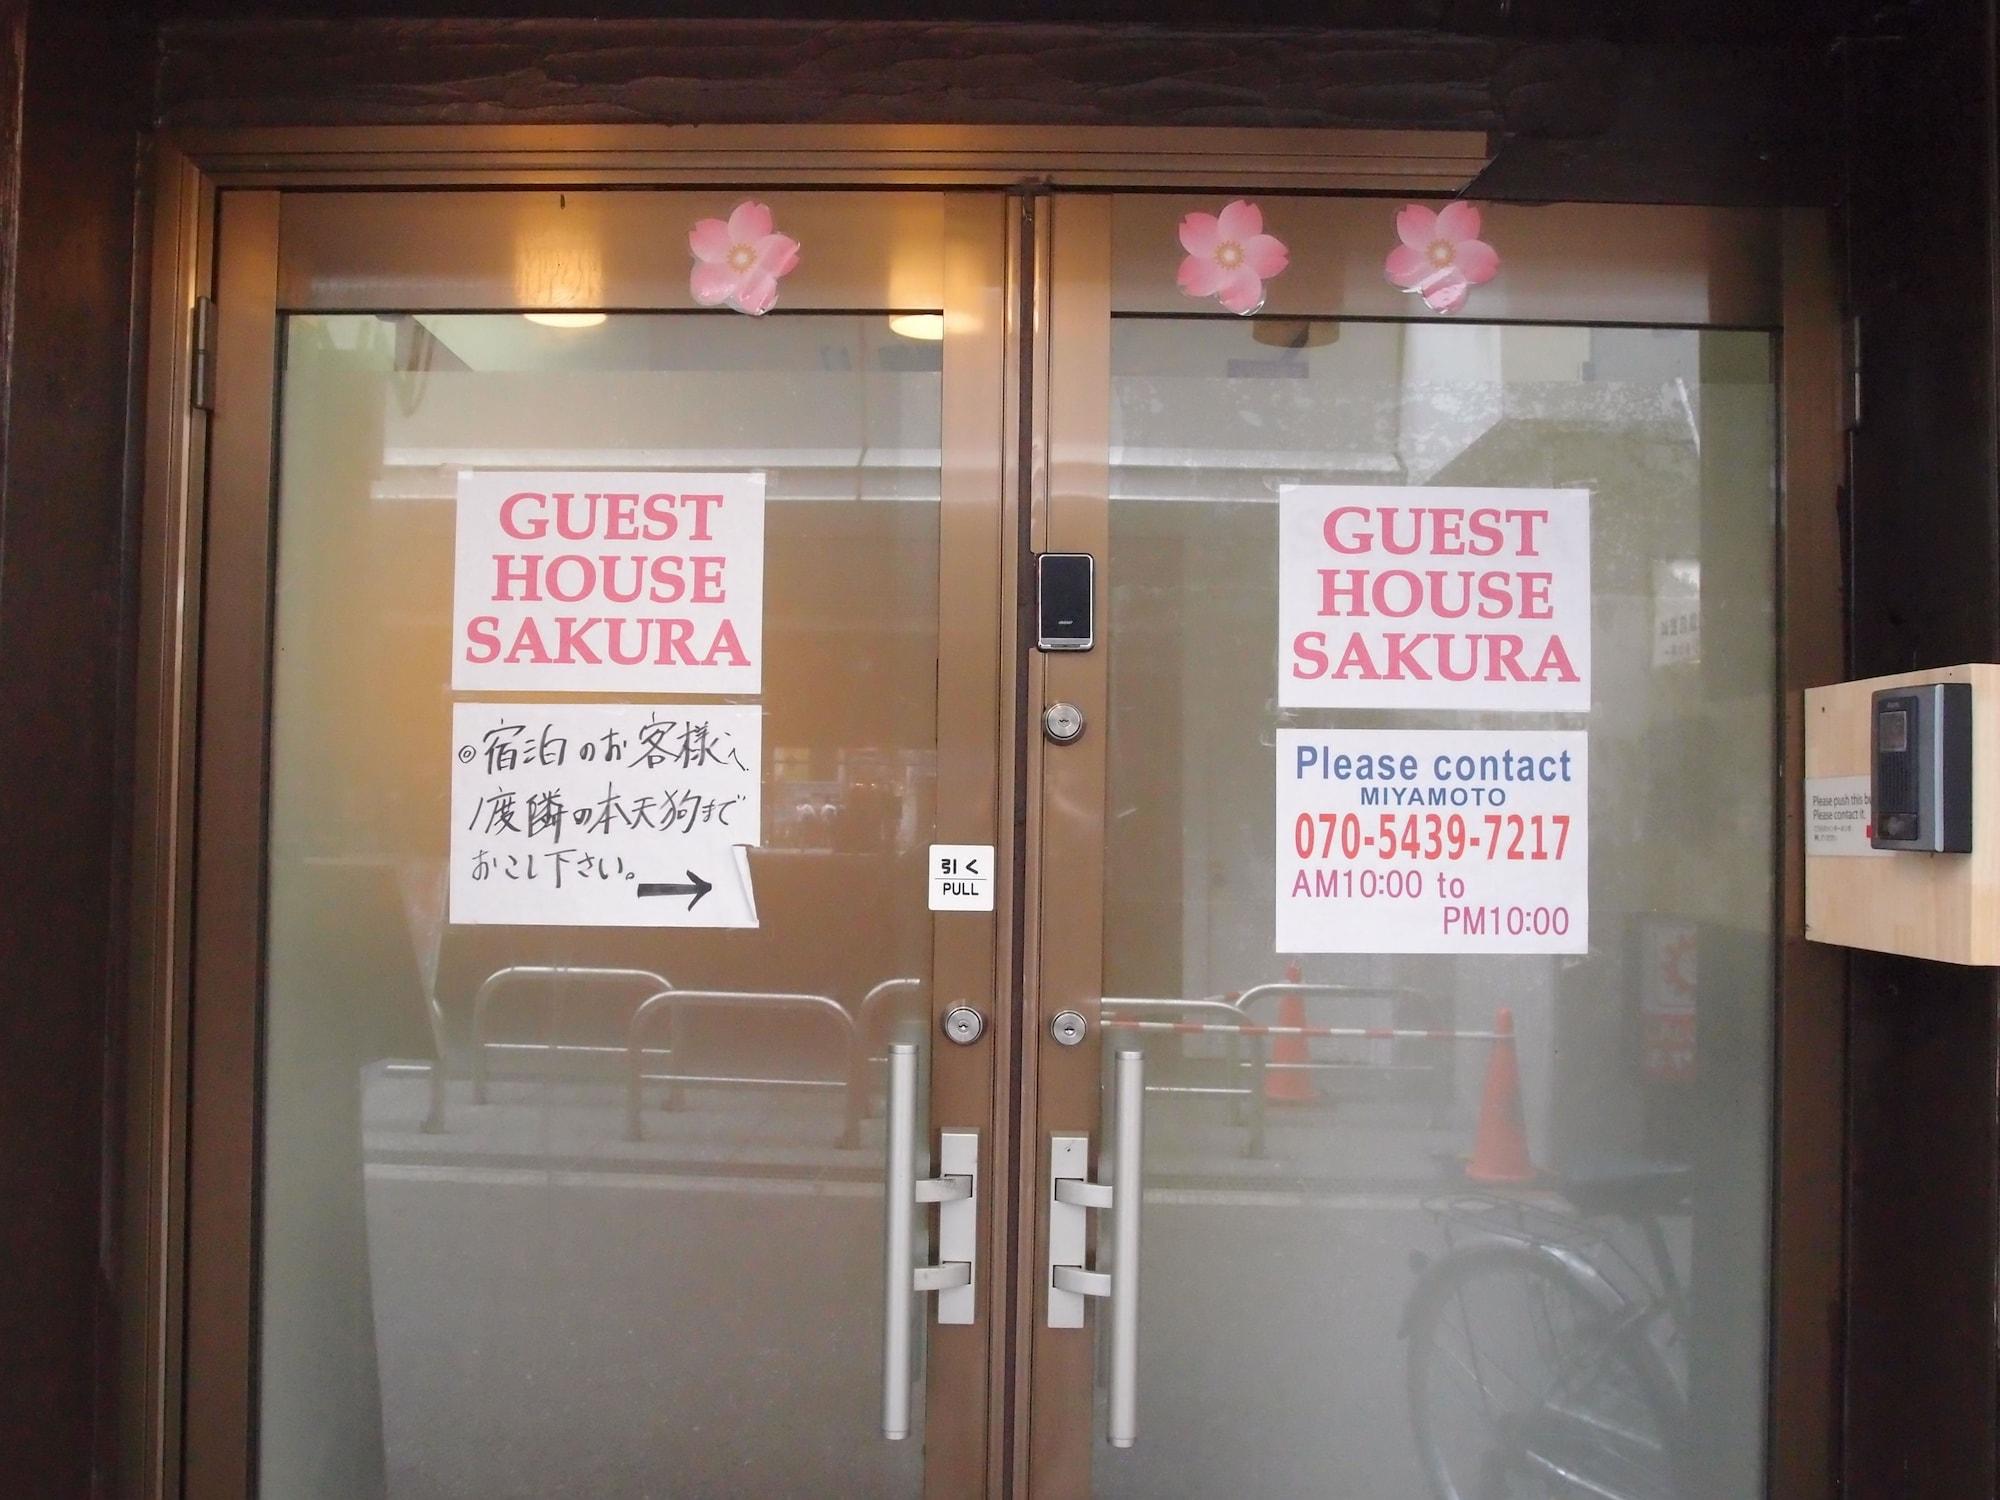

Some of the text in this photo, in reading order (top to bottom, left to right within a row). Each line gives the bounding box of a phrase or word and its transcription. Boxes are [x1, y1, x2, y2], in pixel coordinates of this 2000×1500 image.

[500, 493, 724, 540] GUEST
[1323, 507, 1549, 556] GUEST
[491, 555, 726, 603] HOUSE
[1317, 569, 1554, 619] HOUSE
[466, 616, 751, 666] SAKURA
[1293, 632, 1581, 682] SAKURA
[1297, 746, 1571, 782] Please contact
[1361, 787, 1506, 806] MIYAMOTO
[1812, 794, 1833, 807] Please
[1834, 795, 1850, 808] push
[1850, 793, 1864, 805] this
[1812, 808, 1833, 820] Please
[1834, 808, 1859, 820] contact
[1295, 813, 1570, 860] 070-5439-7217
[941, 858, 979, 875] 引く
[1291, 869, 1465, 899] AM10:00 to
[943, 882, 980, 896] PULL
[1443, 906, 1569, 935] PM10:00
